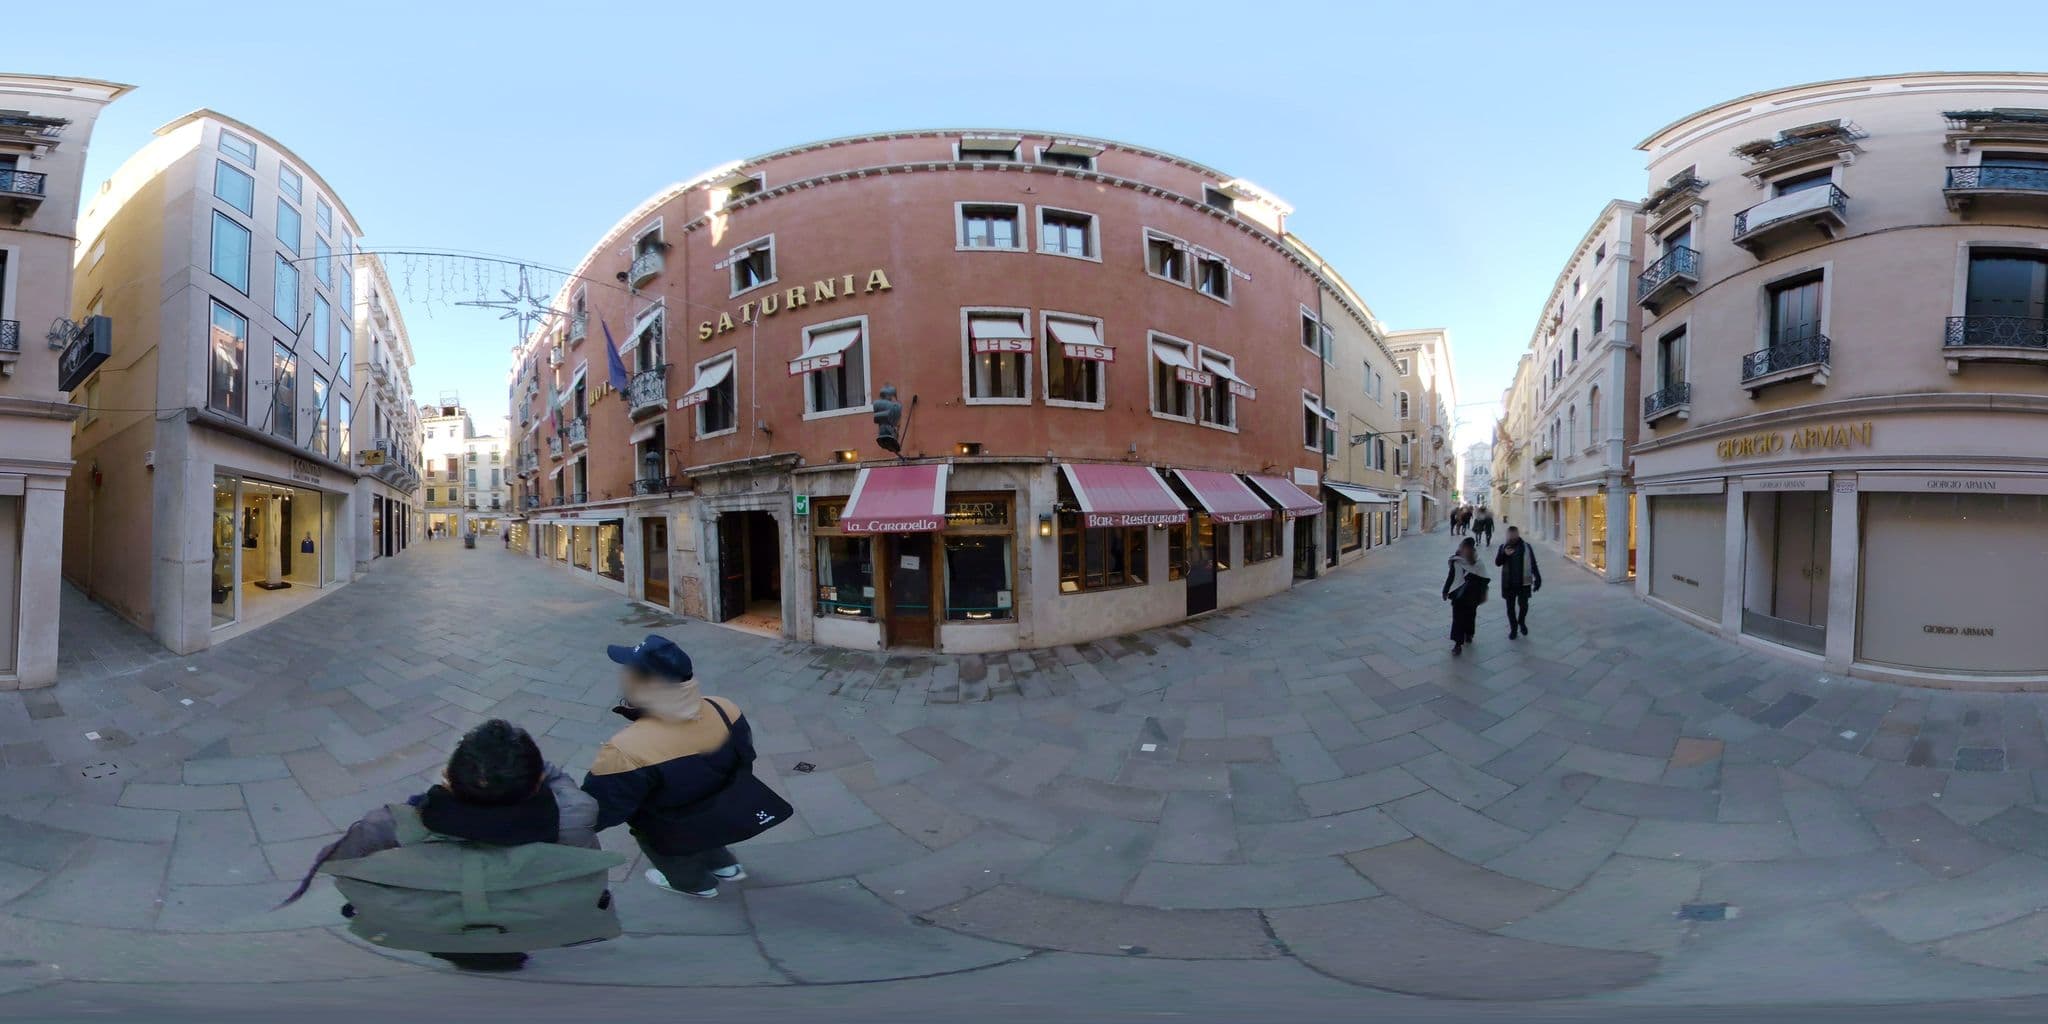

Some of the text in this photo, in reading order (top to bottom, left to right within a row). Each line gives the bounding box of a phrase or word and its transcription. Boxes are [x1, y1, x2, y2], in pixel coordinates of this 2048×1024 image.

[699, 268, 893, 341] SATURNIA
[1717, 421, 1873, 460] GIORGIO ARMANI
[1926, 480, 1997, 489] GIORGIO ARMANI
[1923, 625, 1994, 638] GIORGIO ARMANI
